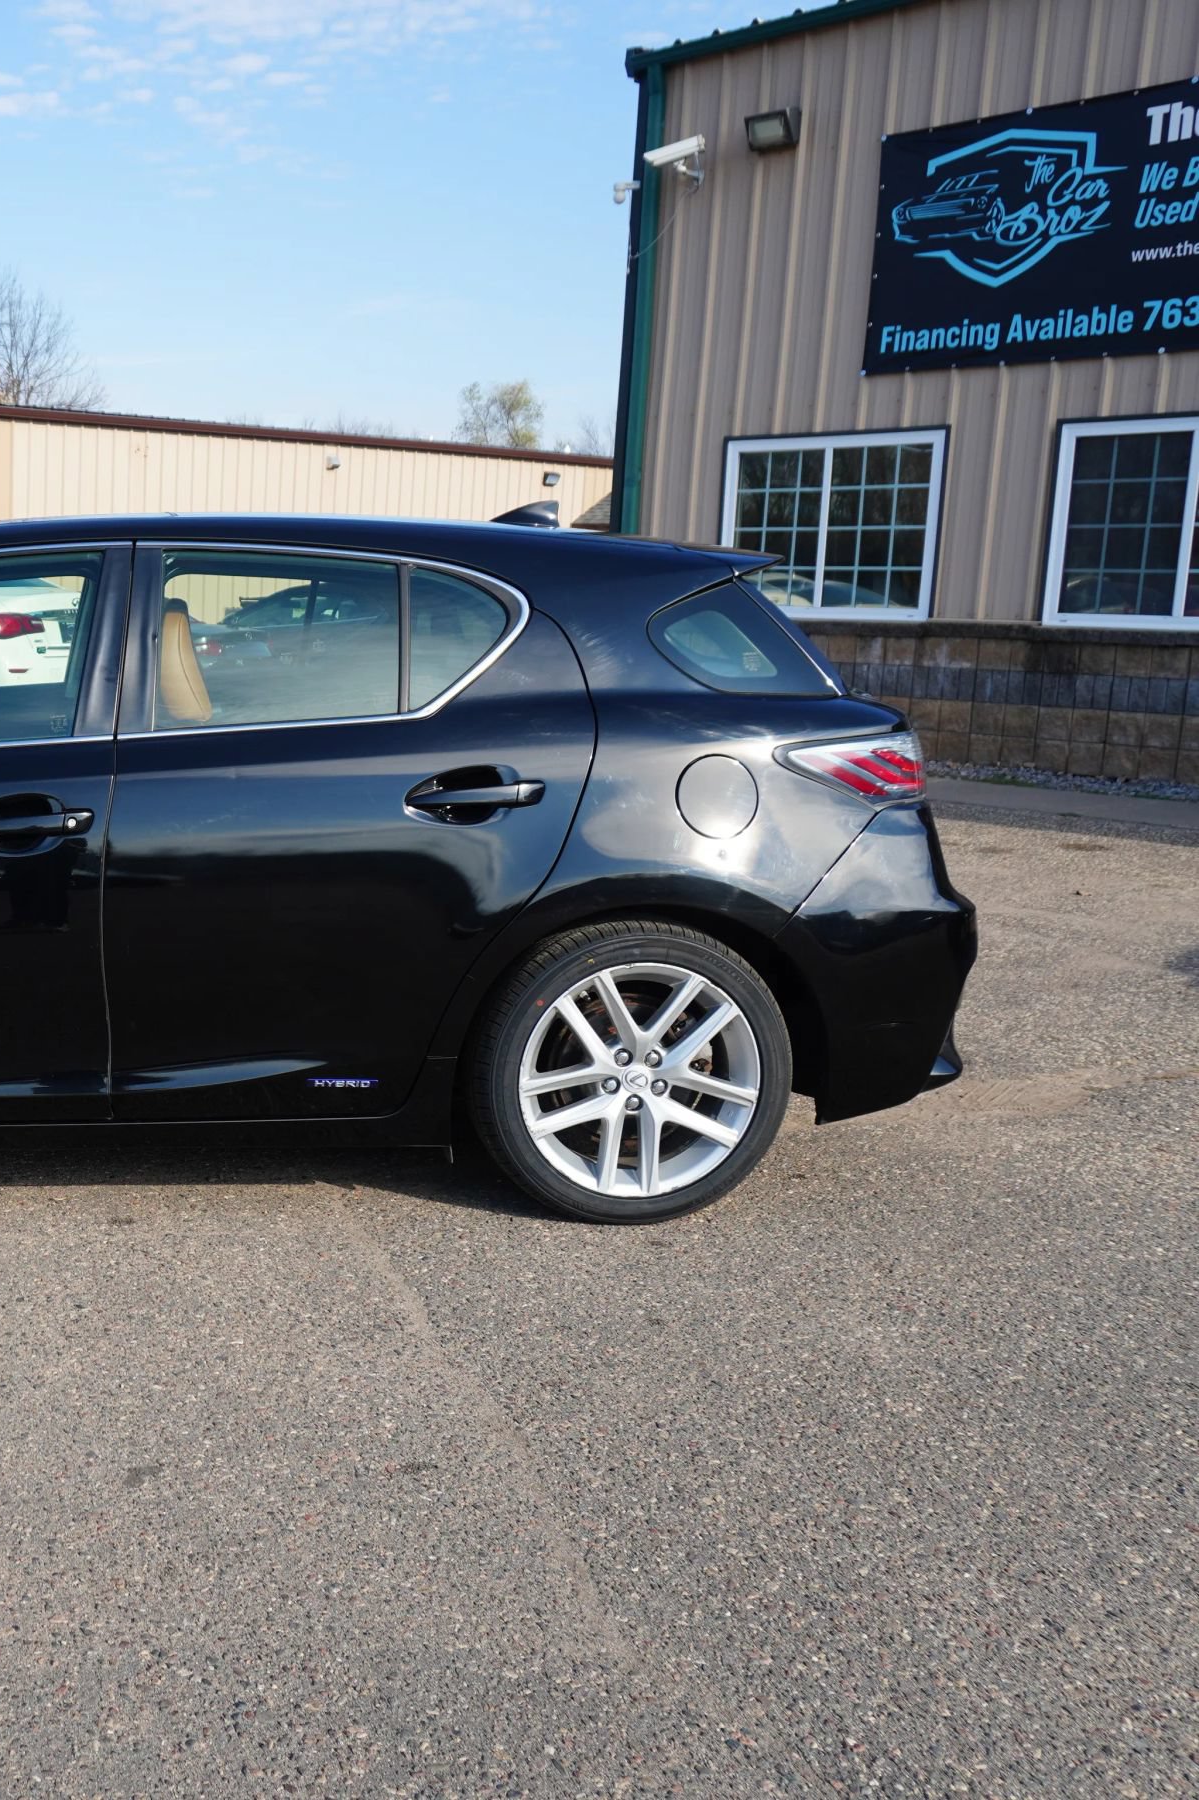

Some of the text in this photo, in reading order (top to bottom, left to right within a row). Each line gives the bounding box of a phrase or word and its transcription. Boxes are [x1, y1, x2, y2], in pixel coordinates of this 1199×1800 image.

[1024, 154, 1057, 193] The
[1047, 166, 1110, 207] Car
[1139, 161, 1179, 193] We
[1134, 192, 1199, 229] Used
[880, 295, 1199, 354] Financing Available 763
